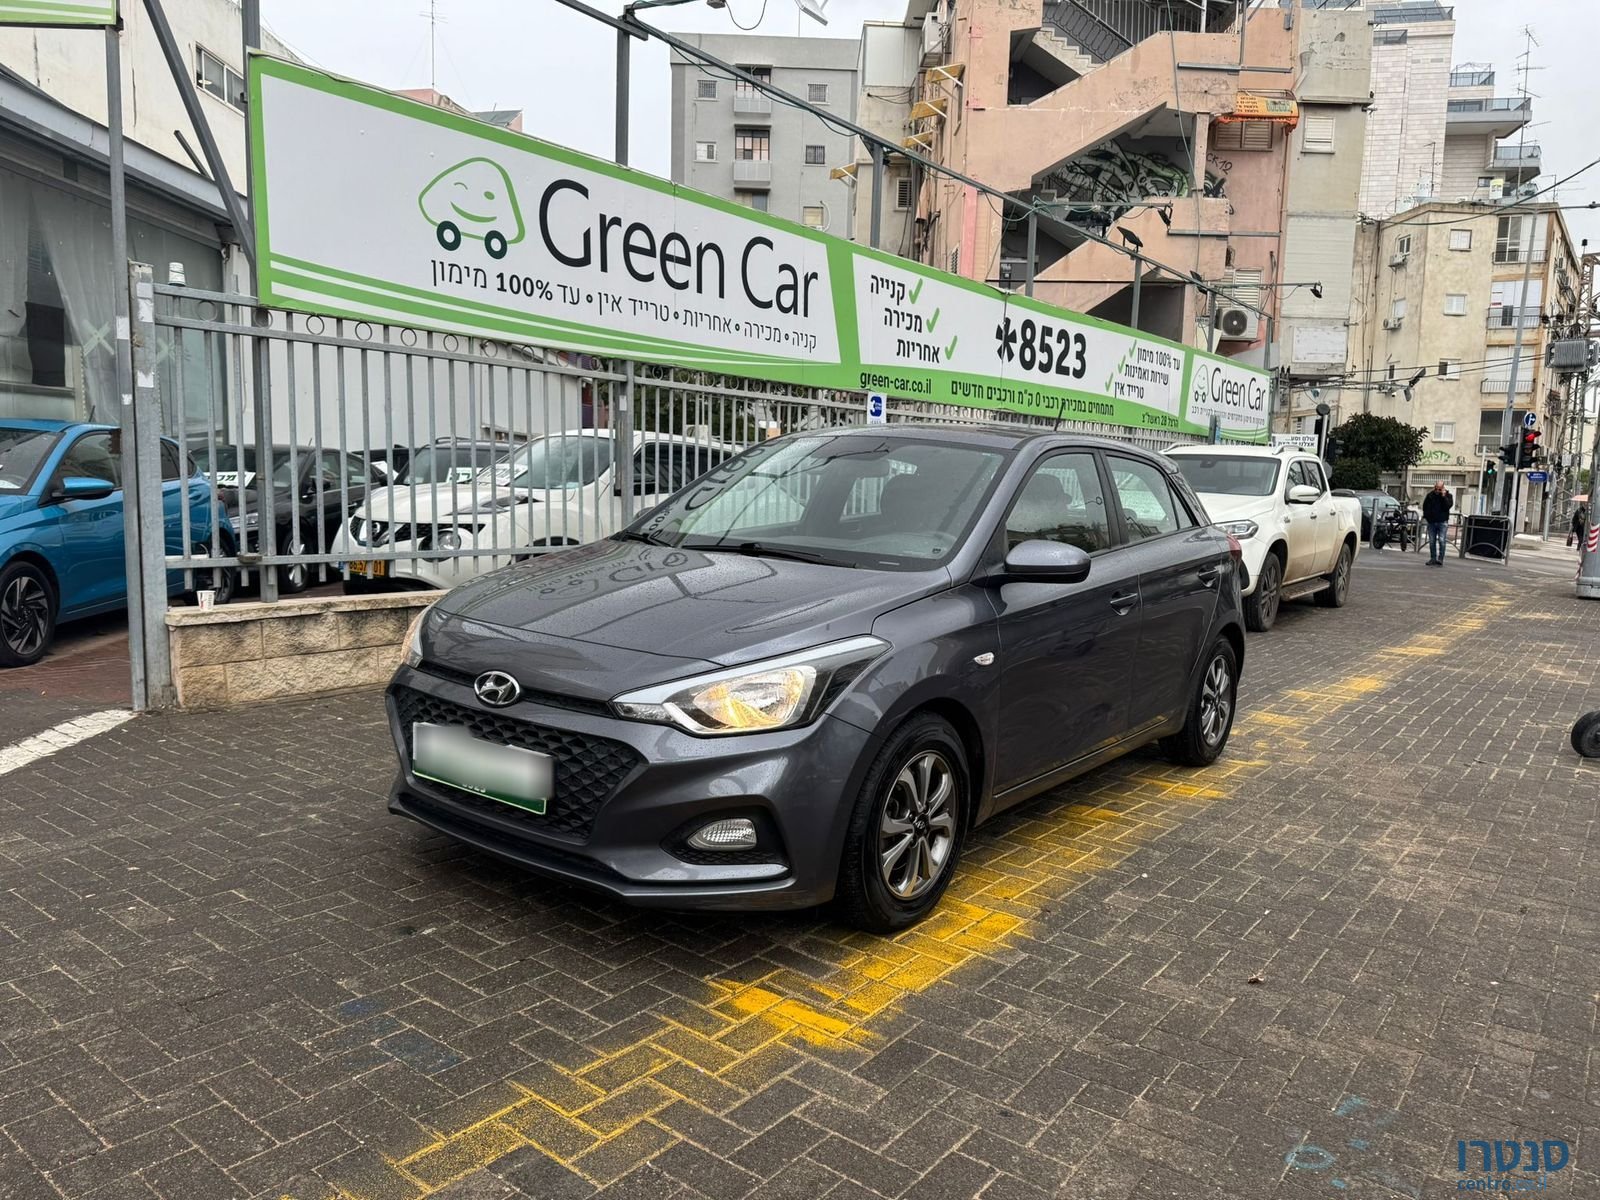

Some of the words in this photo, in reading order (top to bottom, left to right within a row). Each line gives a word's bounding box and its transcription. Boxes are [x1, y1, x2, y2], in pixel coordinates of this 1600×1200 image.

[539, 178, 725, 299] Green
[741, 236, 819, 318] Car
[431, 259, 488, 288] מימון
[496, 272, 553, 301] 100%
[557, 283, 580, 305] עד
[870, 274, 905, 306] קנייה
[597, 292, 623, 316] אין
[628, 298, 670, 322] טרייד
[682, 308, 732, 334] אחריות
[884, 307, 922, 333] מכירה
[744, 321, 782, 343] מכירה
[792, 331, 817, 353] קניה
[896, 338, 940, 363] אחריות
[1137, 347, 1154, 364] מימון
[1155, 350, 1172, 369] 100%
[1124, 364, 1149, 381] ואמינות
[1172, 357, 1181, 371] עד
[860, 372, 932, 394] green-car.co.il
[1150, 370, 1169, 386] שירות
[951, 380, 984, 399] חדשים
[987, 386, 1015, 403] ורכבים
[1114, 381, 1125, 399] אין
[1127, 383, 1145, 399] טרייד
[1211, 367, 1246, 408] Green
[1248, 377, 1266, 412] Car
[1042, 395, 1059, 409] רכבי
[1088, 400, 1114, 416] מתמחים
